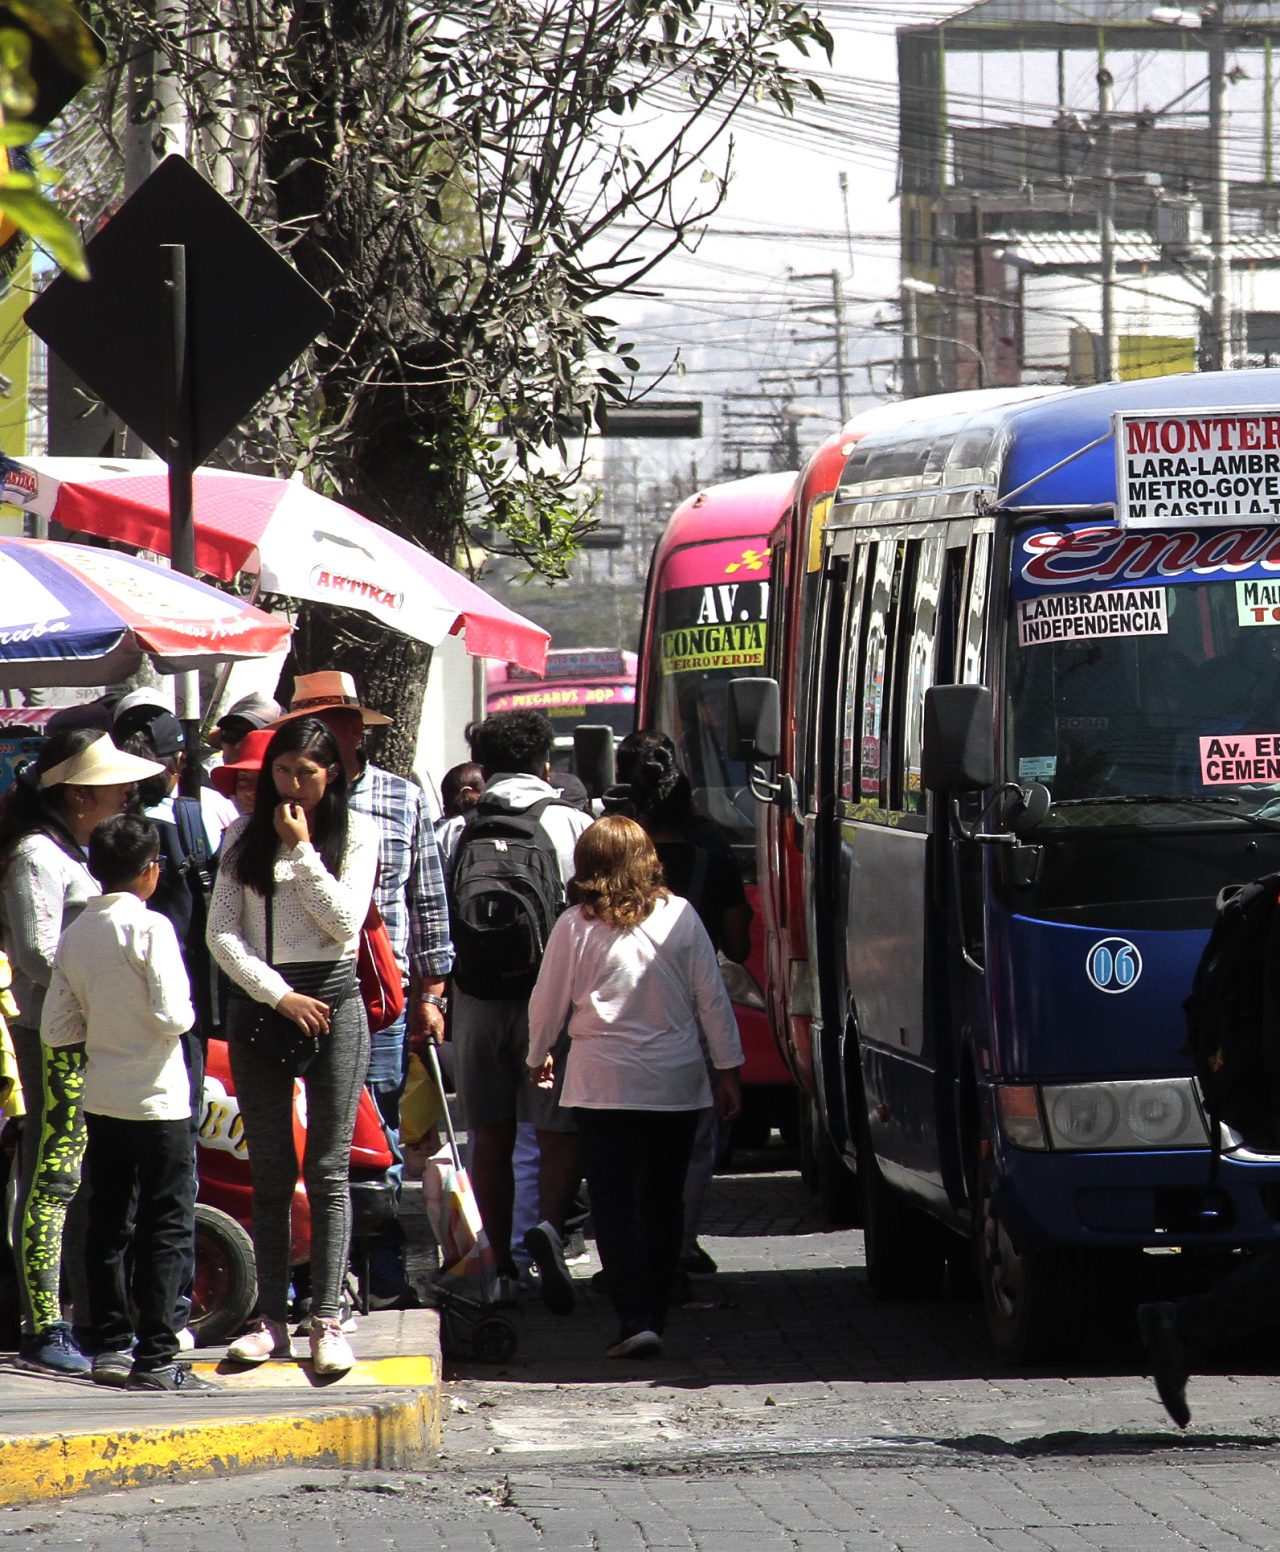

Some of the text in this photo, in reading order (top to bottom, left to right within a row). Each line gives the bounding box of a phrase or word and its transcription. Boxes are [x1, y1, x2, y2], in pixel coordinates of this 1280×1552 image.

[317, 571, 397, 608] ARTIKA
[697, 584, 749, 625] AV.
[1021, 590, 1162, 622] LAMBRAMANI
[0, 620, 71, 646] ruba
[663, 623, 763, 659] CONGATA
[1022, 611, 1163, 643] INDEPENDENCIA
[1093, 945, 1135, 986] 06
